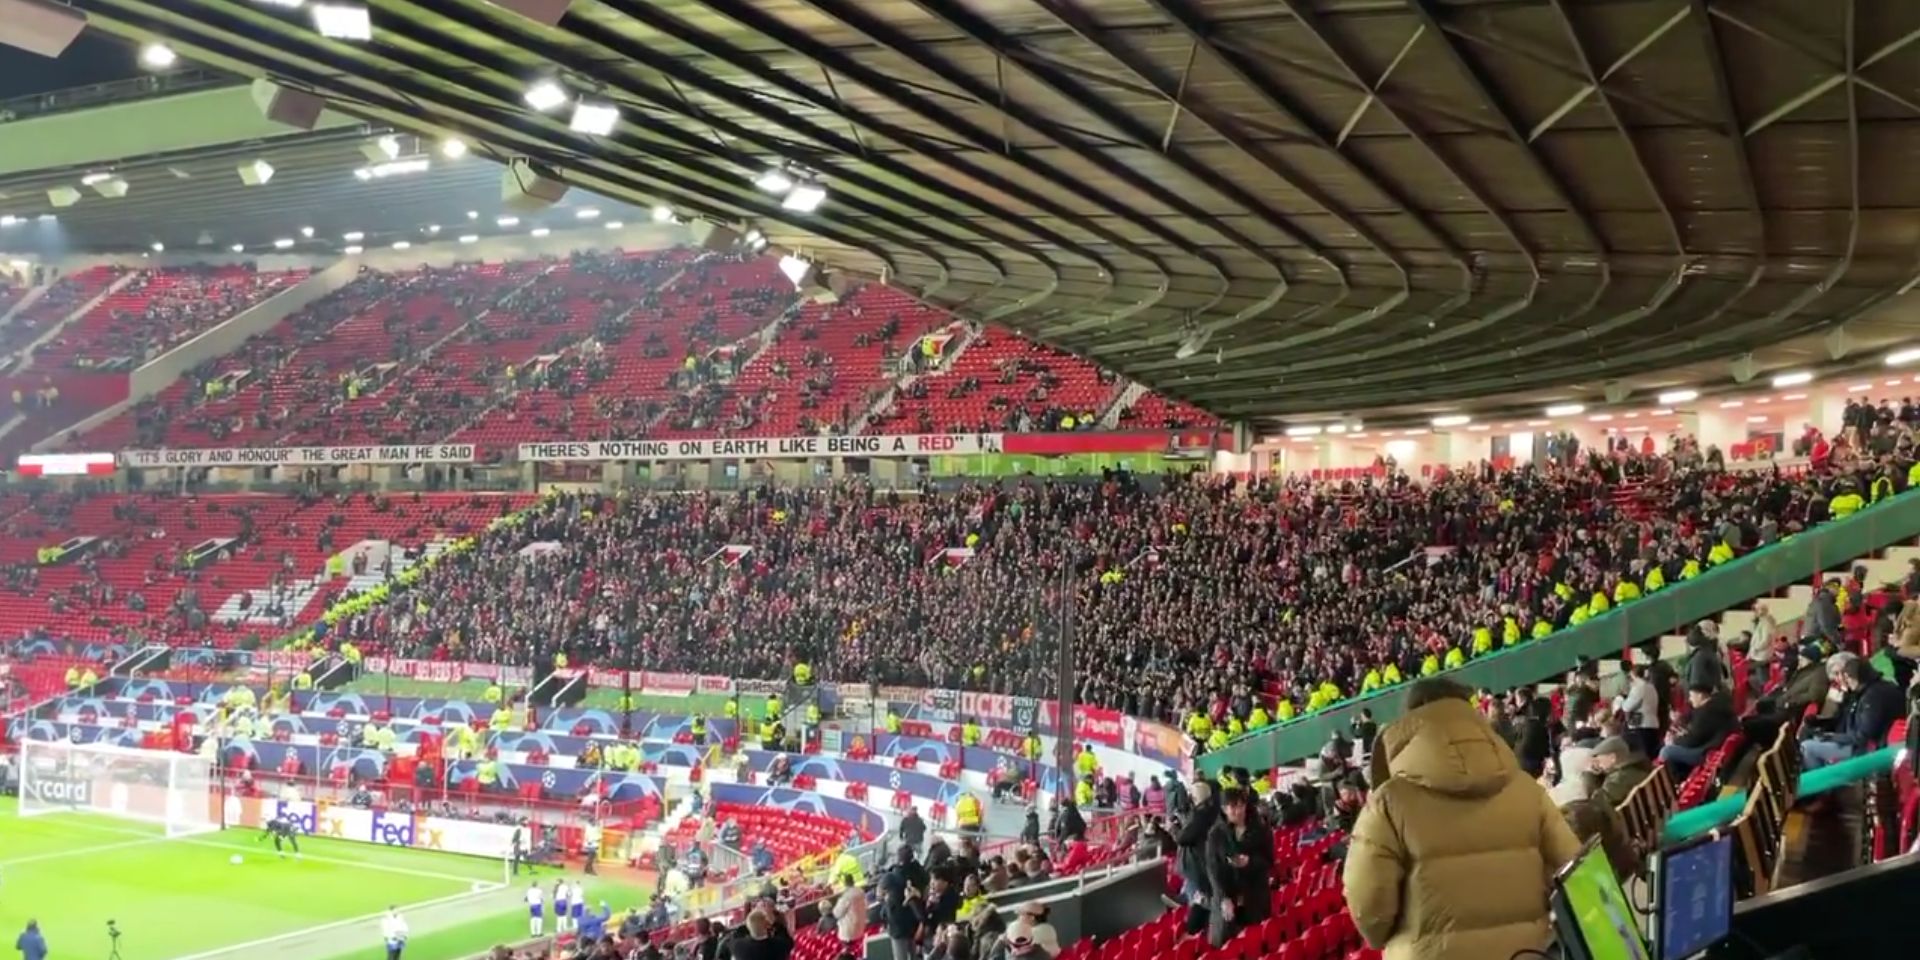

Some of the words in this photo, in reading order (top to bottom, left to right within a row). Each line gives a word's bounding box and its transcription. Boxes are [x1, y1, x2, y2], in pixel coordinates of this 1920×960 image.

[165, 451, 202, 464] GLORY
[208, 450, 233, 463] AND
[302, 448, 325, 461] THE
[331, 447, 373, 461] GREAT
[379, 447, 409, 460] MAN
[415, 446, 433, 459] HE
[440, 446, 472, 459] SAID
[521, 443, 590, 458] "THERE'S
[599, 442, 668, 456] NOTHING
[679, 441, 701, 455] ON
[712, 440, 768, 454] EARTH
[779, 439, 817, 452] LIKE
[828, 437, 880, 452] BEING
[892, 437, 906, 450] A
[917, 436, 964, 450] RED"
[276, 799, 344, 837] FedEx
[371, 809, 443, 848] FedEx
